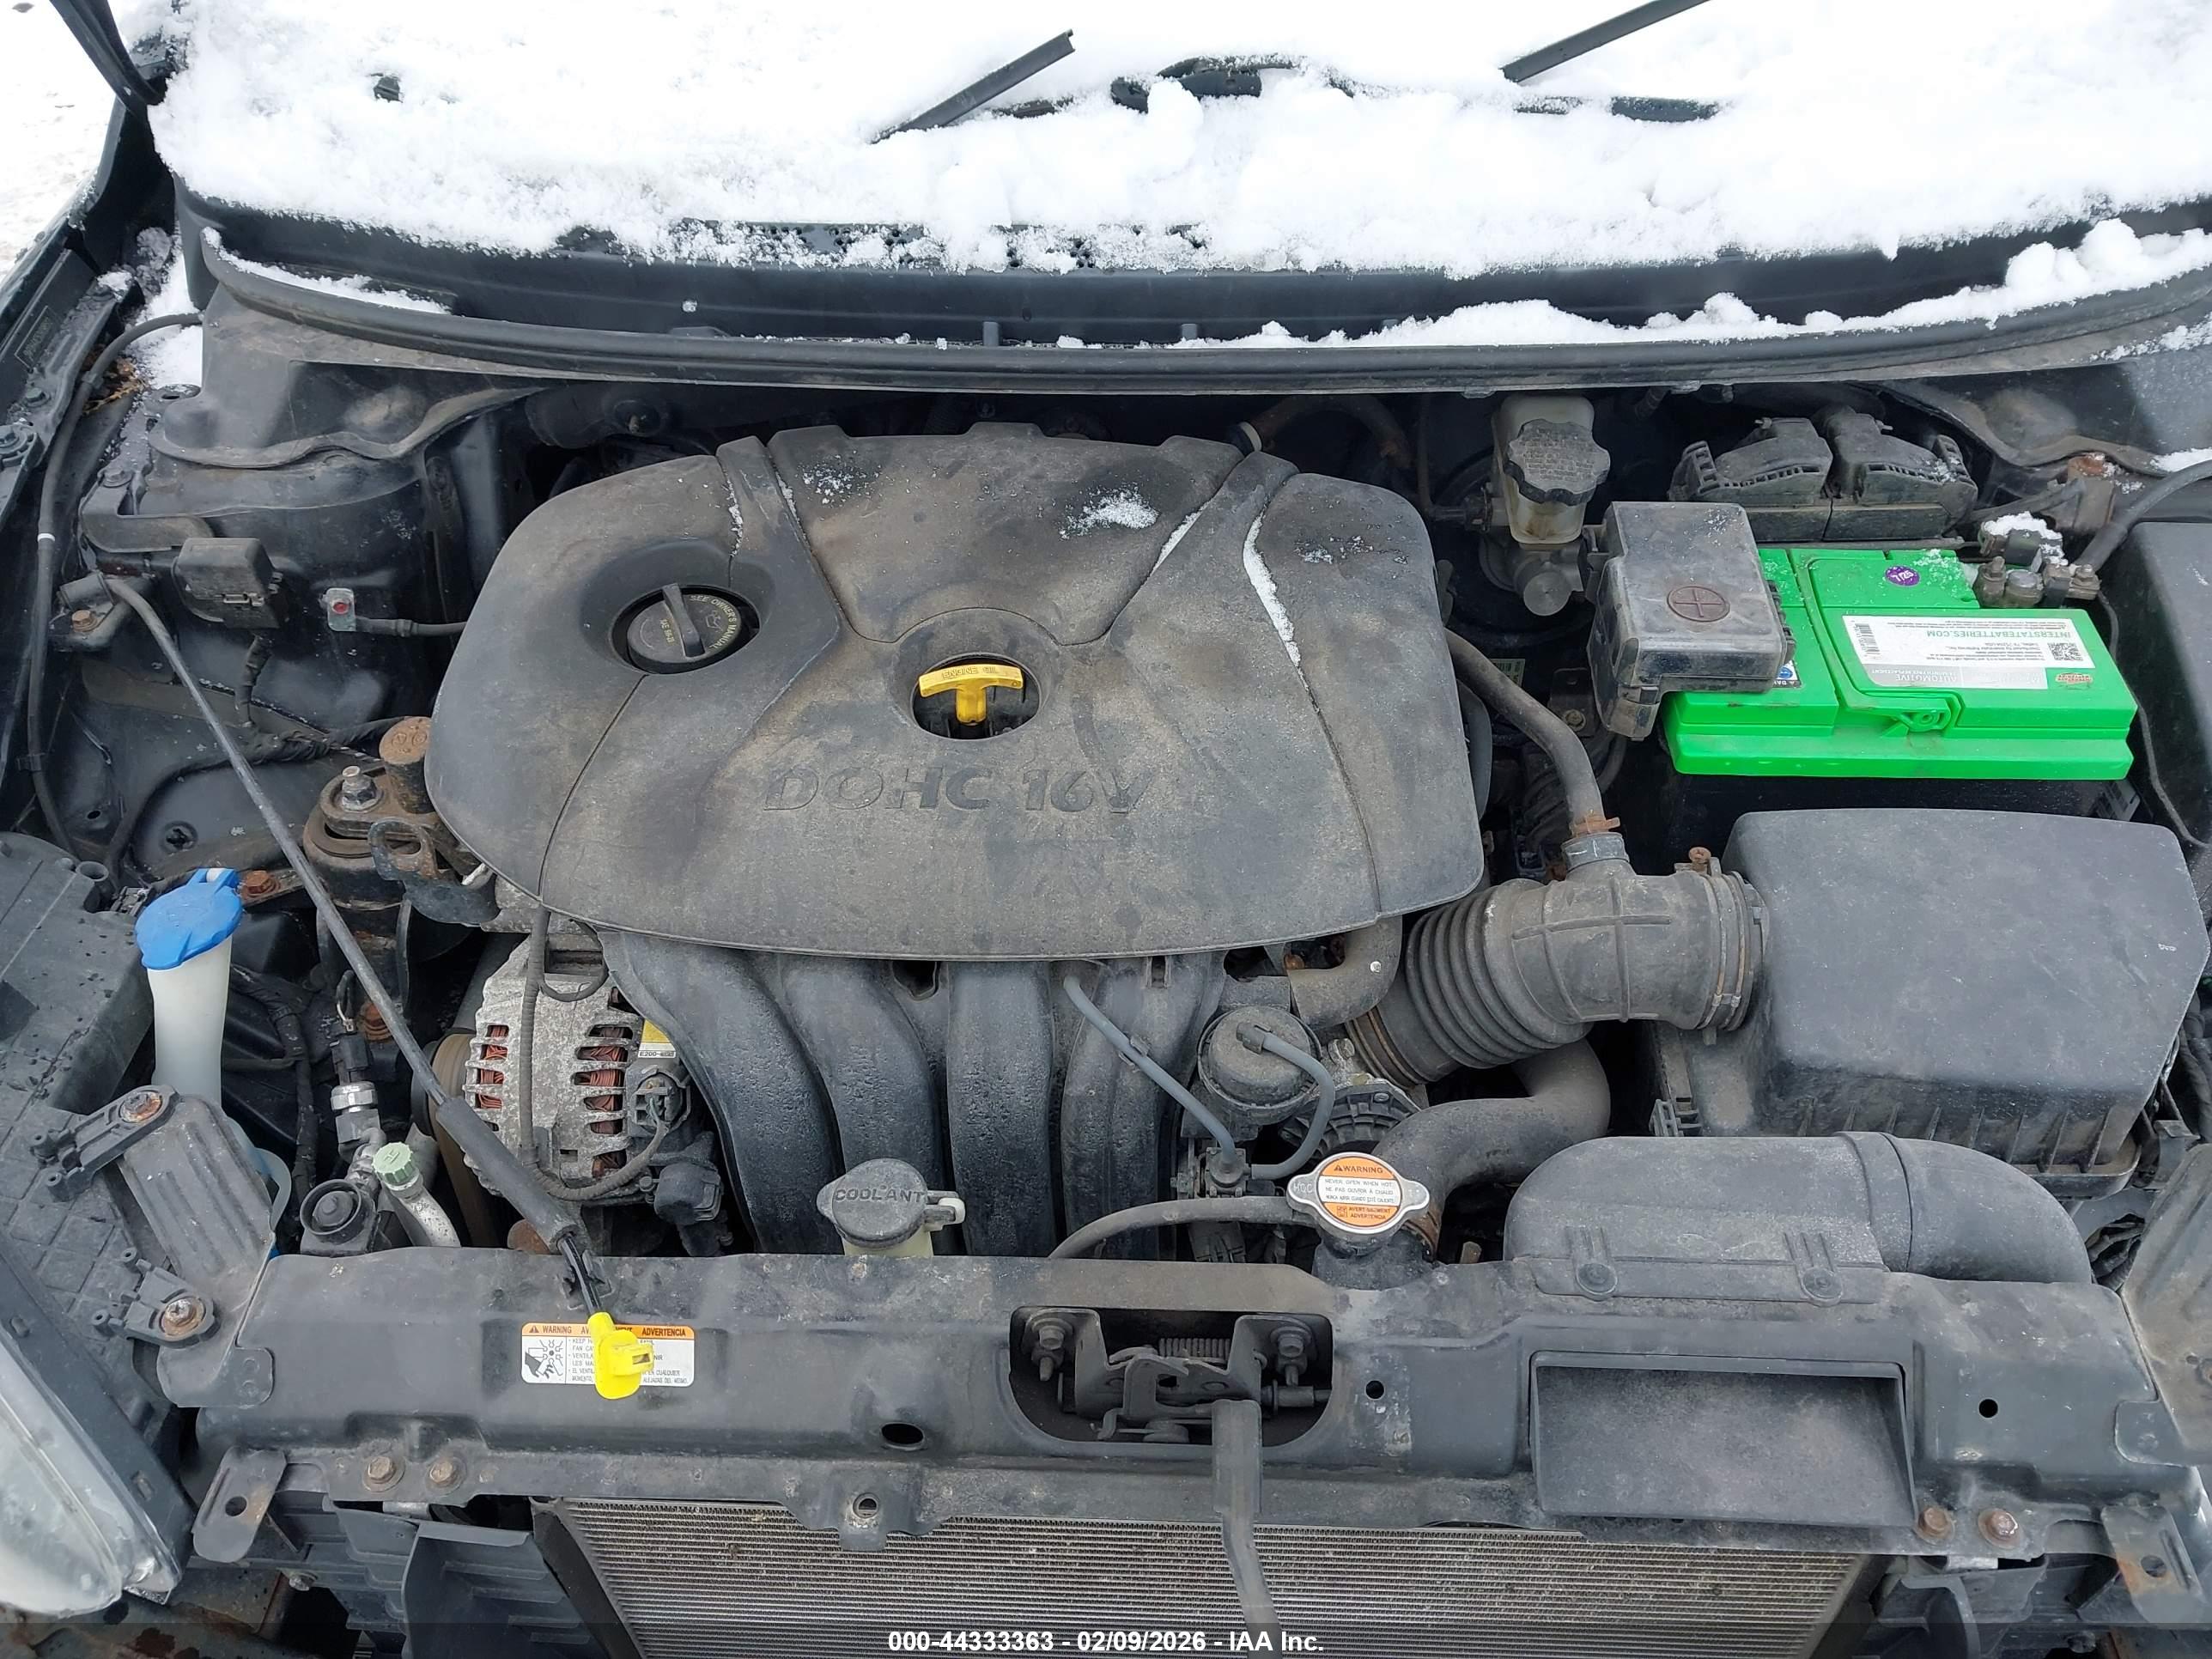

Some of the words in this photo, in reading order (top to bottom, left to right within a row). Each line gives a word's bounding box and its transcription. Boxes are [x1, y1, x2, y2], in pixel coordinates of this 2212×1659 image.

[1890, 569, 1914, 581] 7/25
[708, 624, 737, 649] MANUAL
[1926, 629, 2071, 639] INTERSTATEBATTERIES.COM
[941, 666, 978, 679] ENGINE
[1895, 674, 1957, 683] AUTOMOTIVE
[763, 766, 993, 811] DOHC
[1022, 767, 1156, 814] 16V
[1342, 1165, 1383, 1174] WARNING
[835, 1188, 925, 1203] COOLANT
[542, 1325, 573, 1334] WARNING
[641, 1328, 686, 1337] ADVERTENCIA
